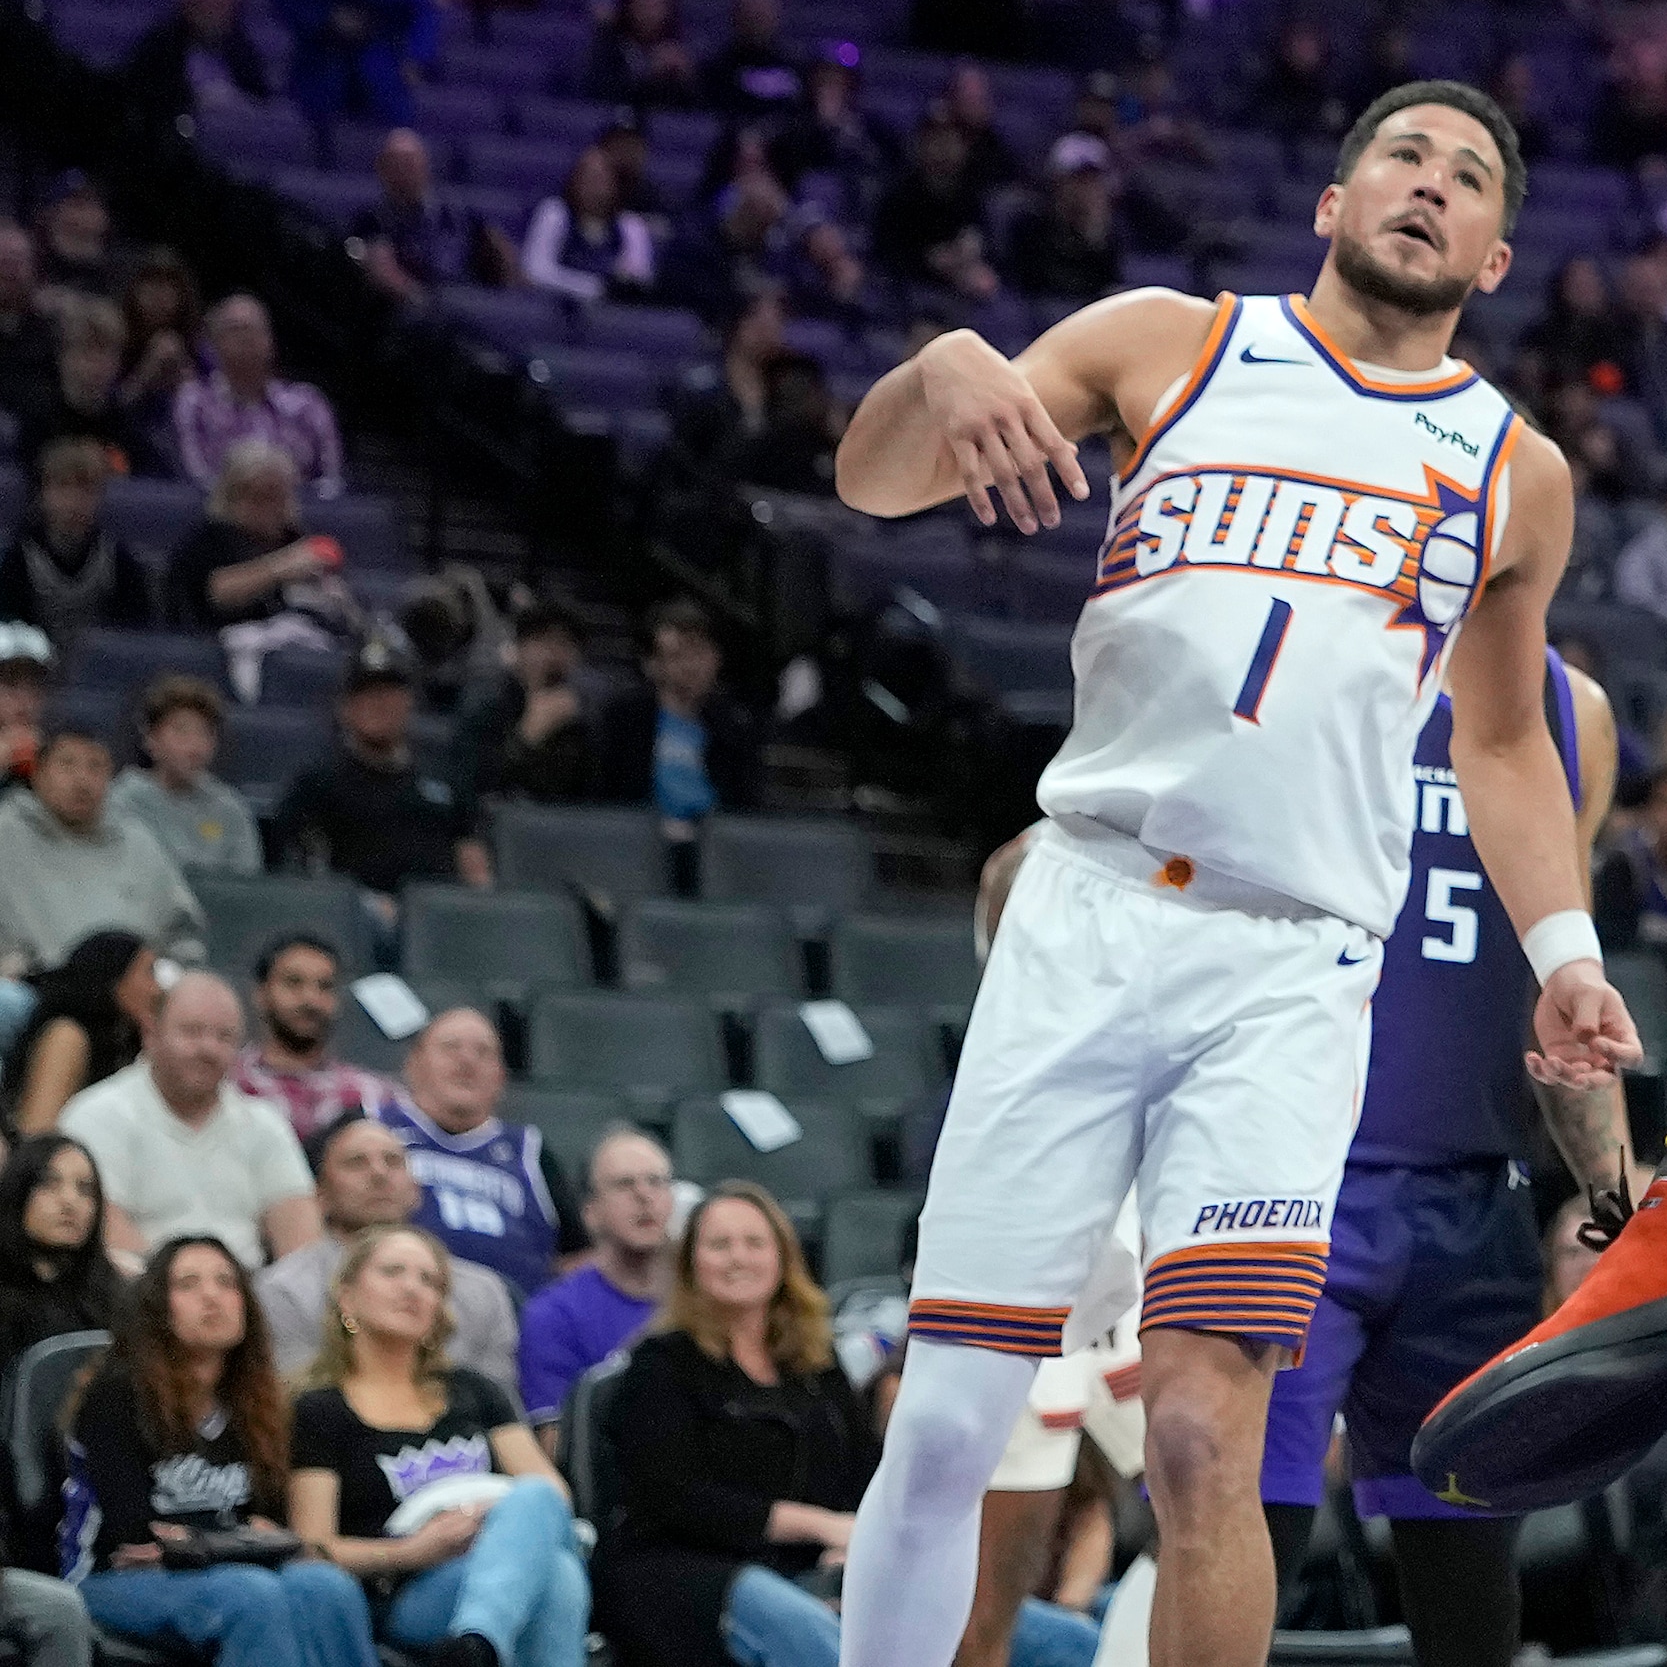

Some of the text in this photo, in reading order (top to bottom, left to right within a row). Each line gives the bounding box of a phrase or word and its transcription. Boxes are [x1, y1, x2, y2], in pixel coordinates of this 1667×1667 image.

[1413, 410, 1481, 460] PayPal
[1133, 472, 1418, 589] SUNS
[1232, 595, 1294, 726] 1
[1421, 865, 1484, 965] 5
[1191, 1198, 1323, 1235] PHOENIX
